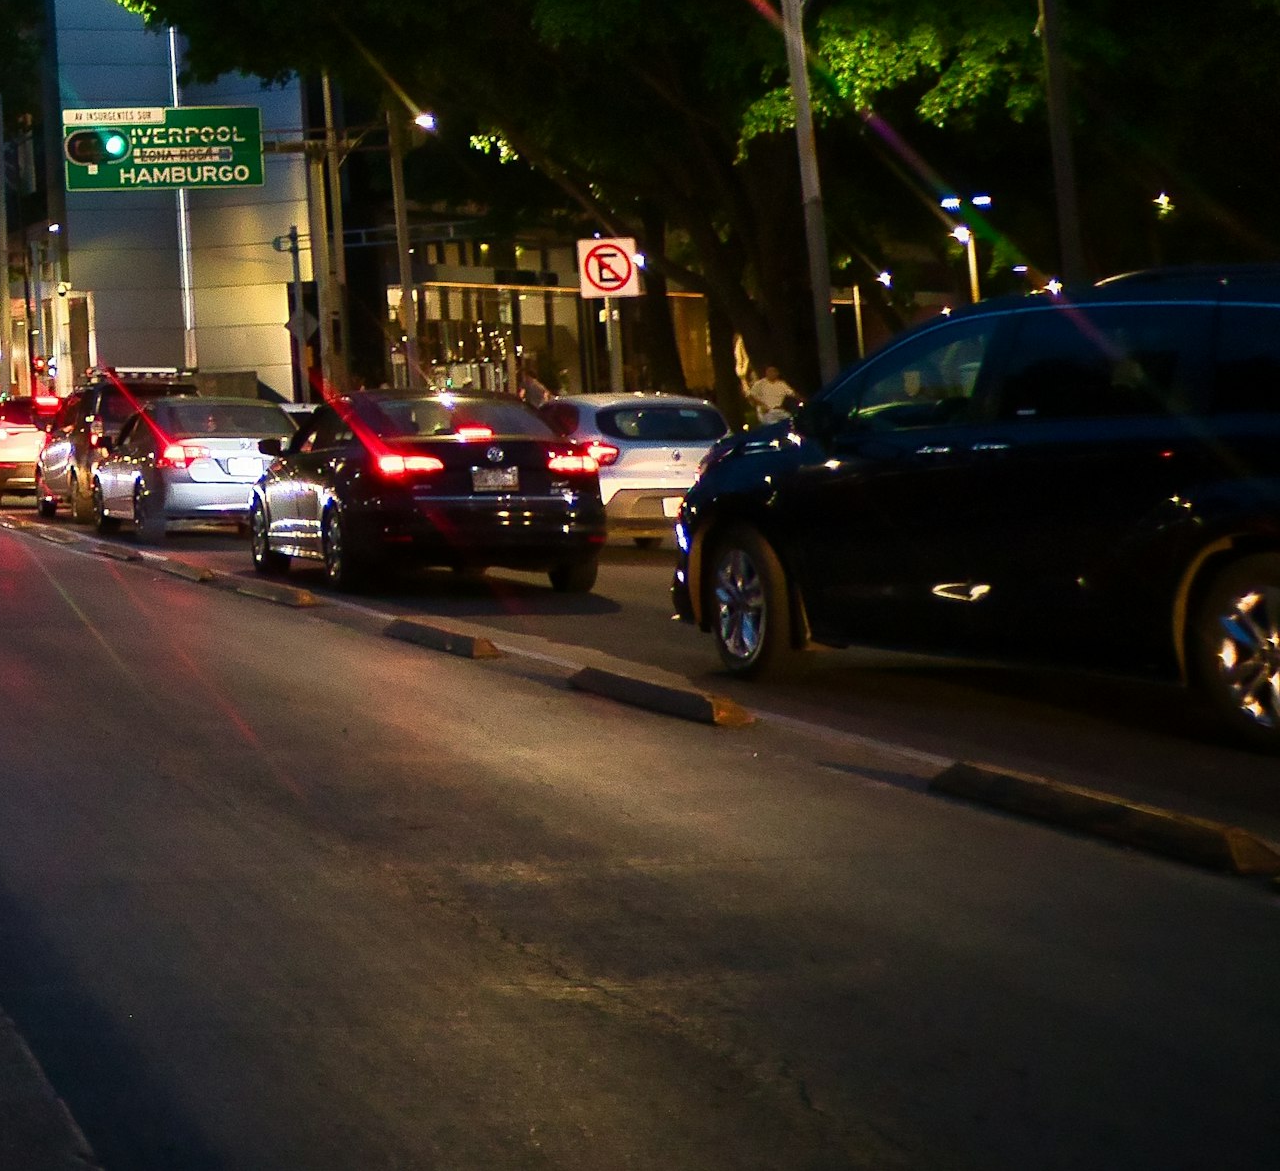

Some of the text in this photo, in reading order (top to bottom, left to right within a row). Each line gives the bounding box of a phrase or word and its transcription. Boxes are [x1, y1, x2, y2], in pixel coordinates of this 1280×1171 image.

[87, 111, 134, 121] INSURGENTES
[137, 111, 152, 120] SUR
[179, 148, 214, 161] ROSA
[119, 165, 250, 184] HAMBURGO
